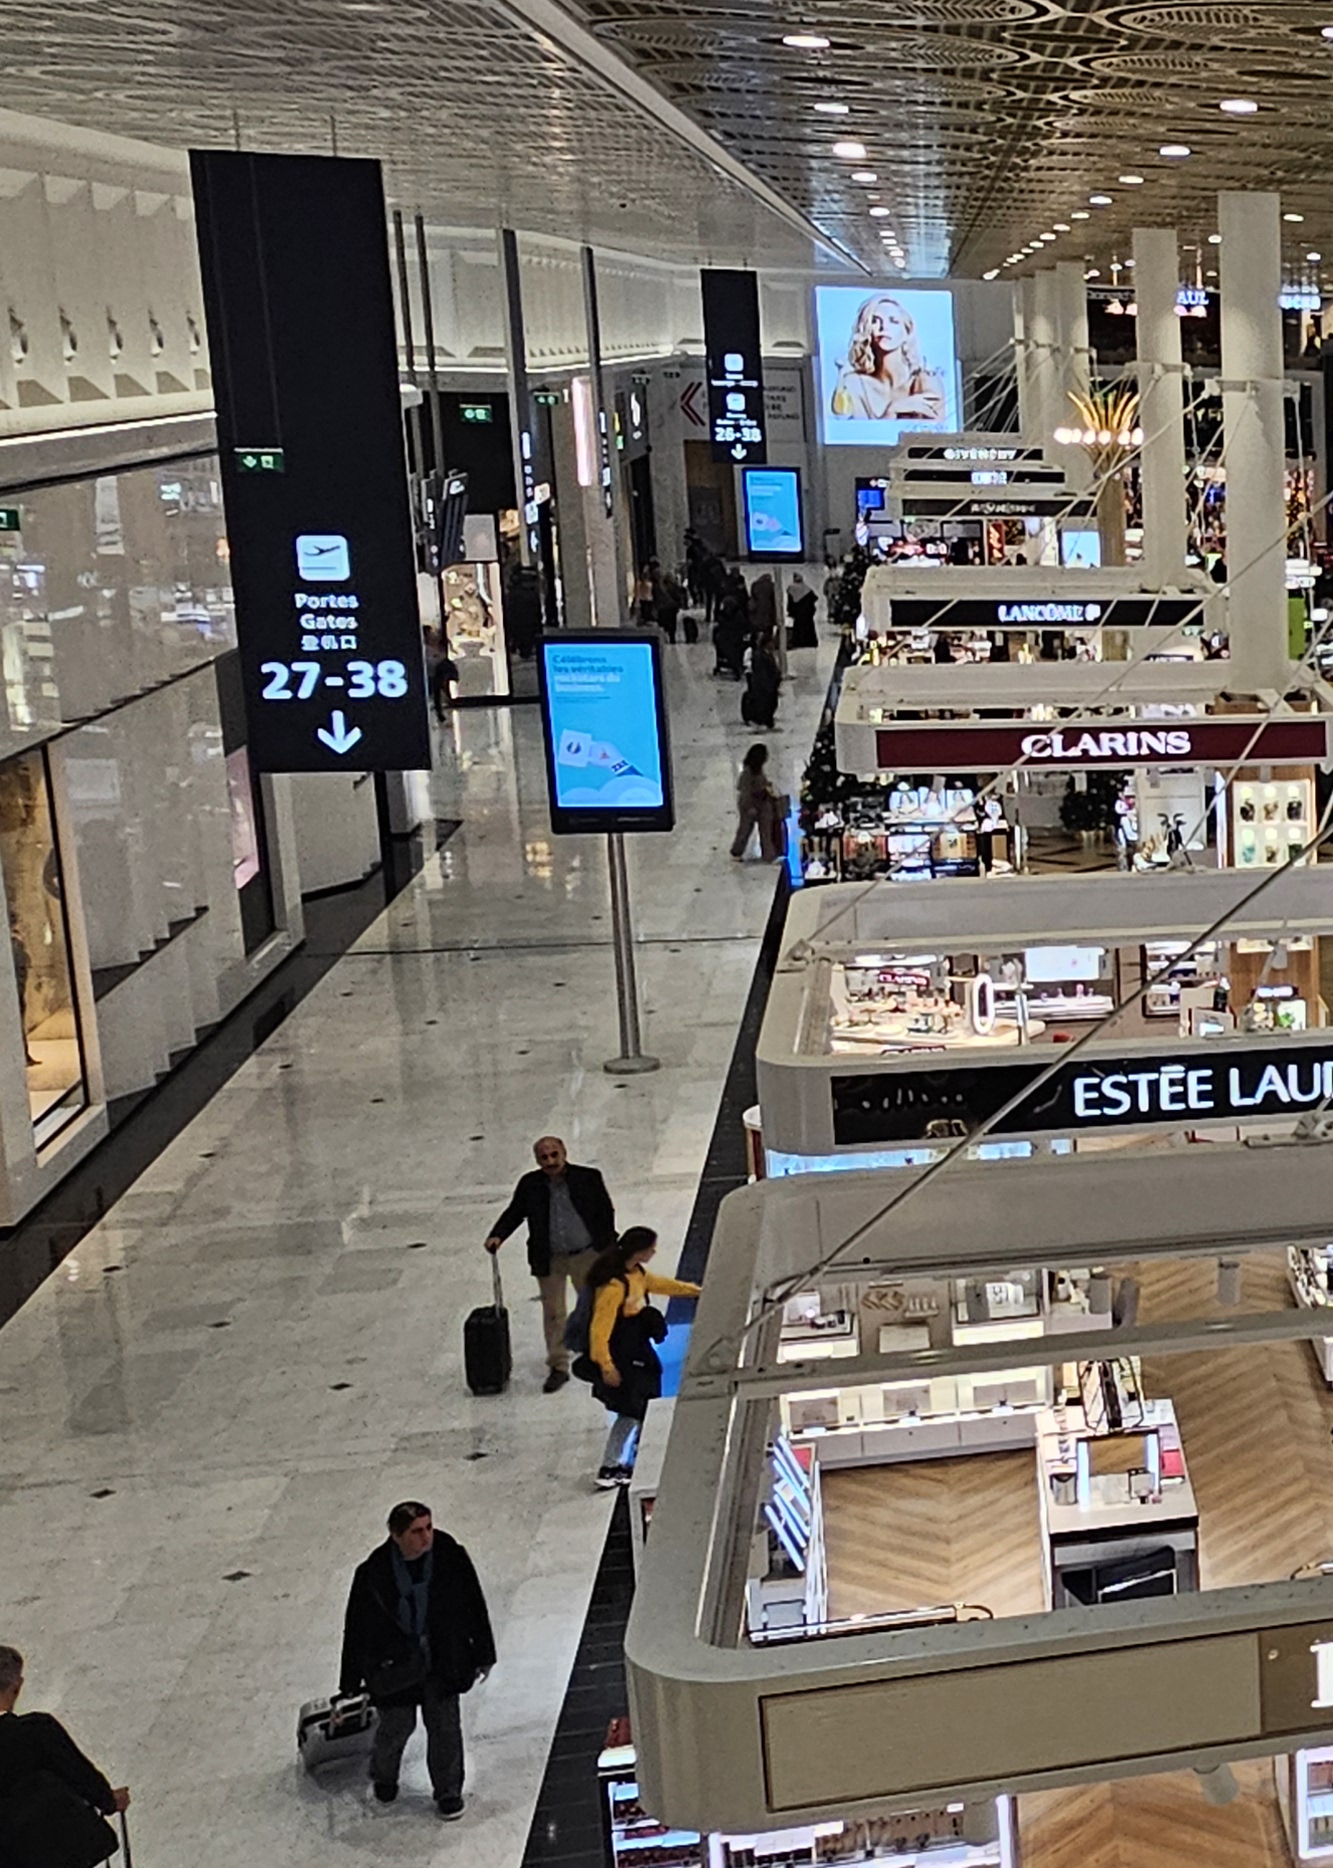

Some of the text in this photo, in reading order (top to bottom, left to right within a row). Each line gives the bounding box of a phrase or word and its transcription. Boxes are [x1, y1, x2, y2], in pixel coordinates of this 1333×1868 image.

[1176, 291, 1209, 305] AUL
[294, 593, 359, 609] Portes
[300, 613, 358, 630] Gates
[260, 660, 408, 699] 27-38
[1021, 731, 1191, 758] CLARINS
